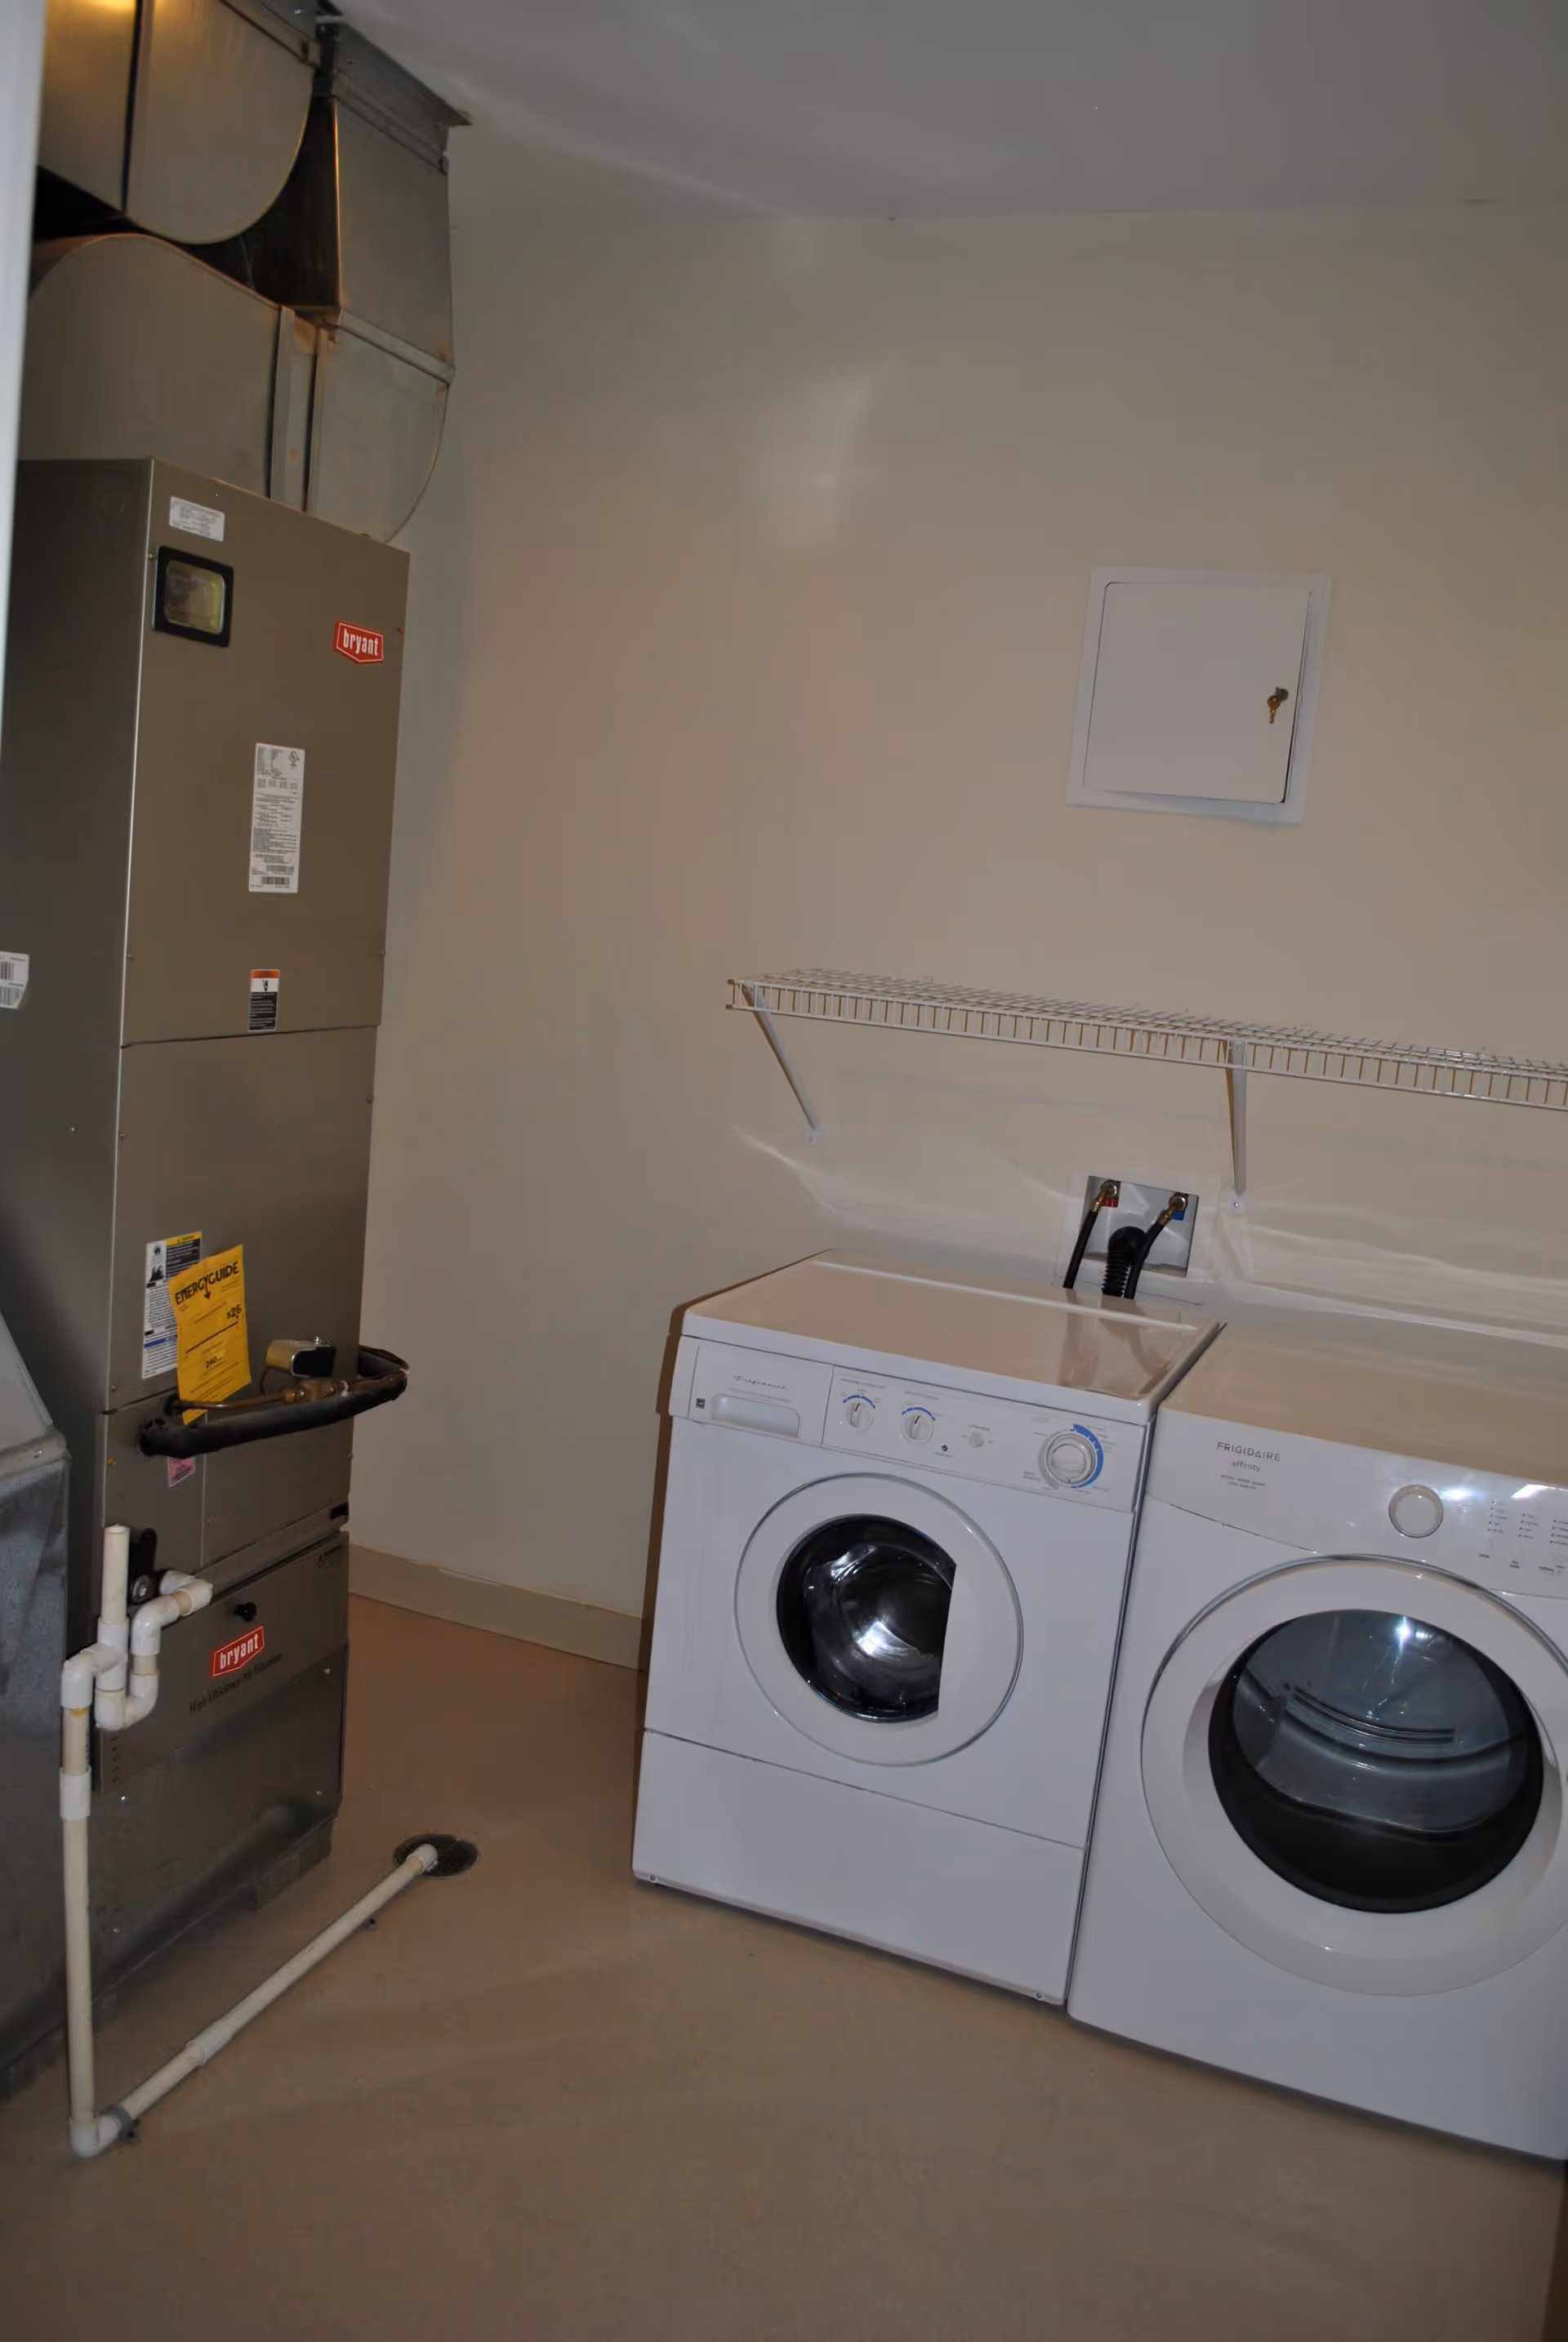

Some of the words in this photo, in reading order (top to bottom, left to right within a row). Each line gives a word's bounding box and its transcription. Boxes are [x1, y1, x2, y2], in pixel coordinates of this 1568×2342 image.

[343, 628, 378, 657] bryant
[174, 1261, 239, 1307] ENERGYGUIDE
[1217, 1441, 1281, 1462] FRIGIDAIRE
[1231, 1460, 1262, 1472] affinity
[220, 1633, 259, 1669] bryant
